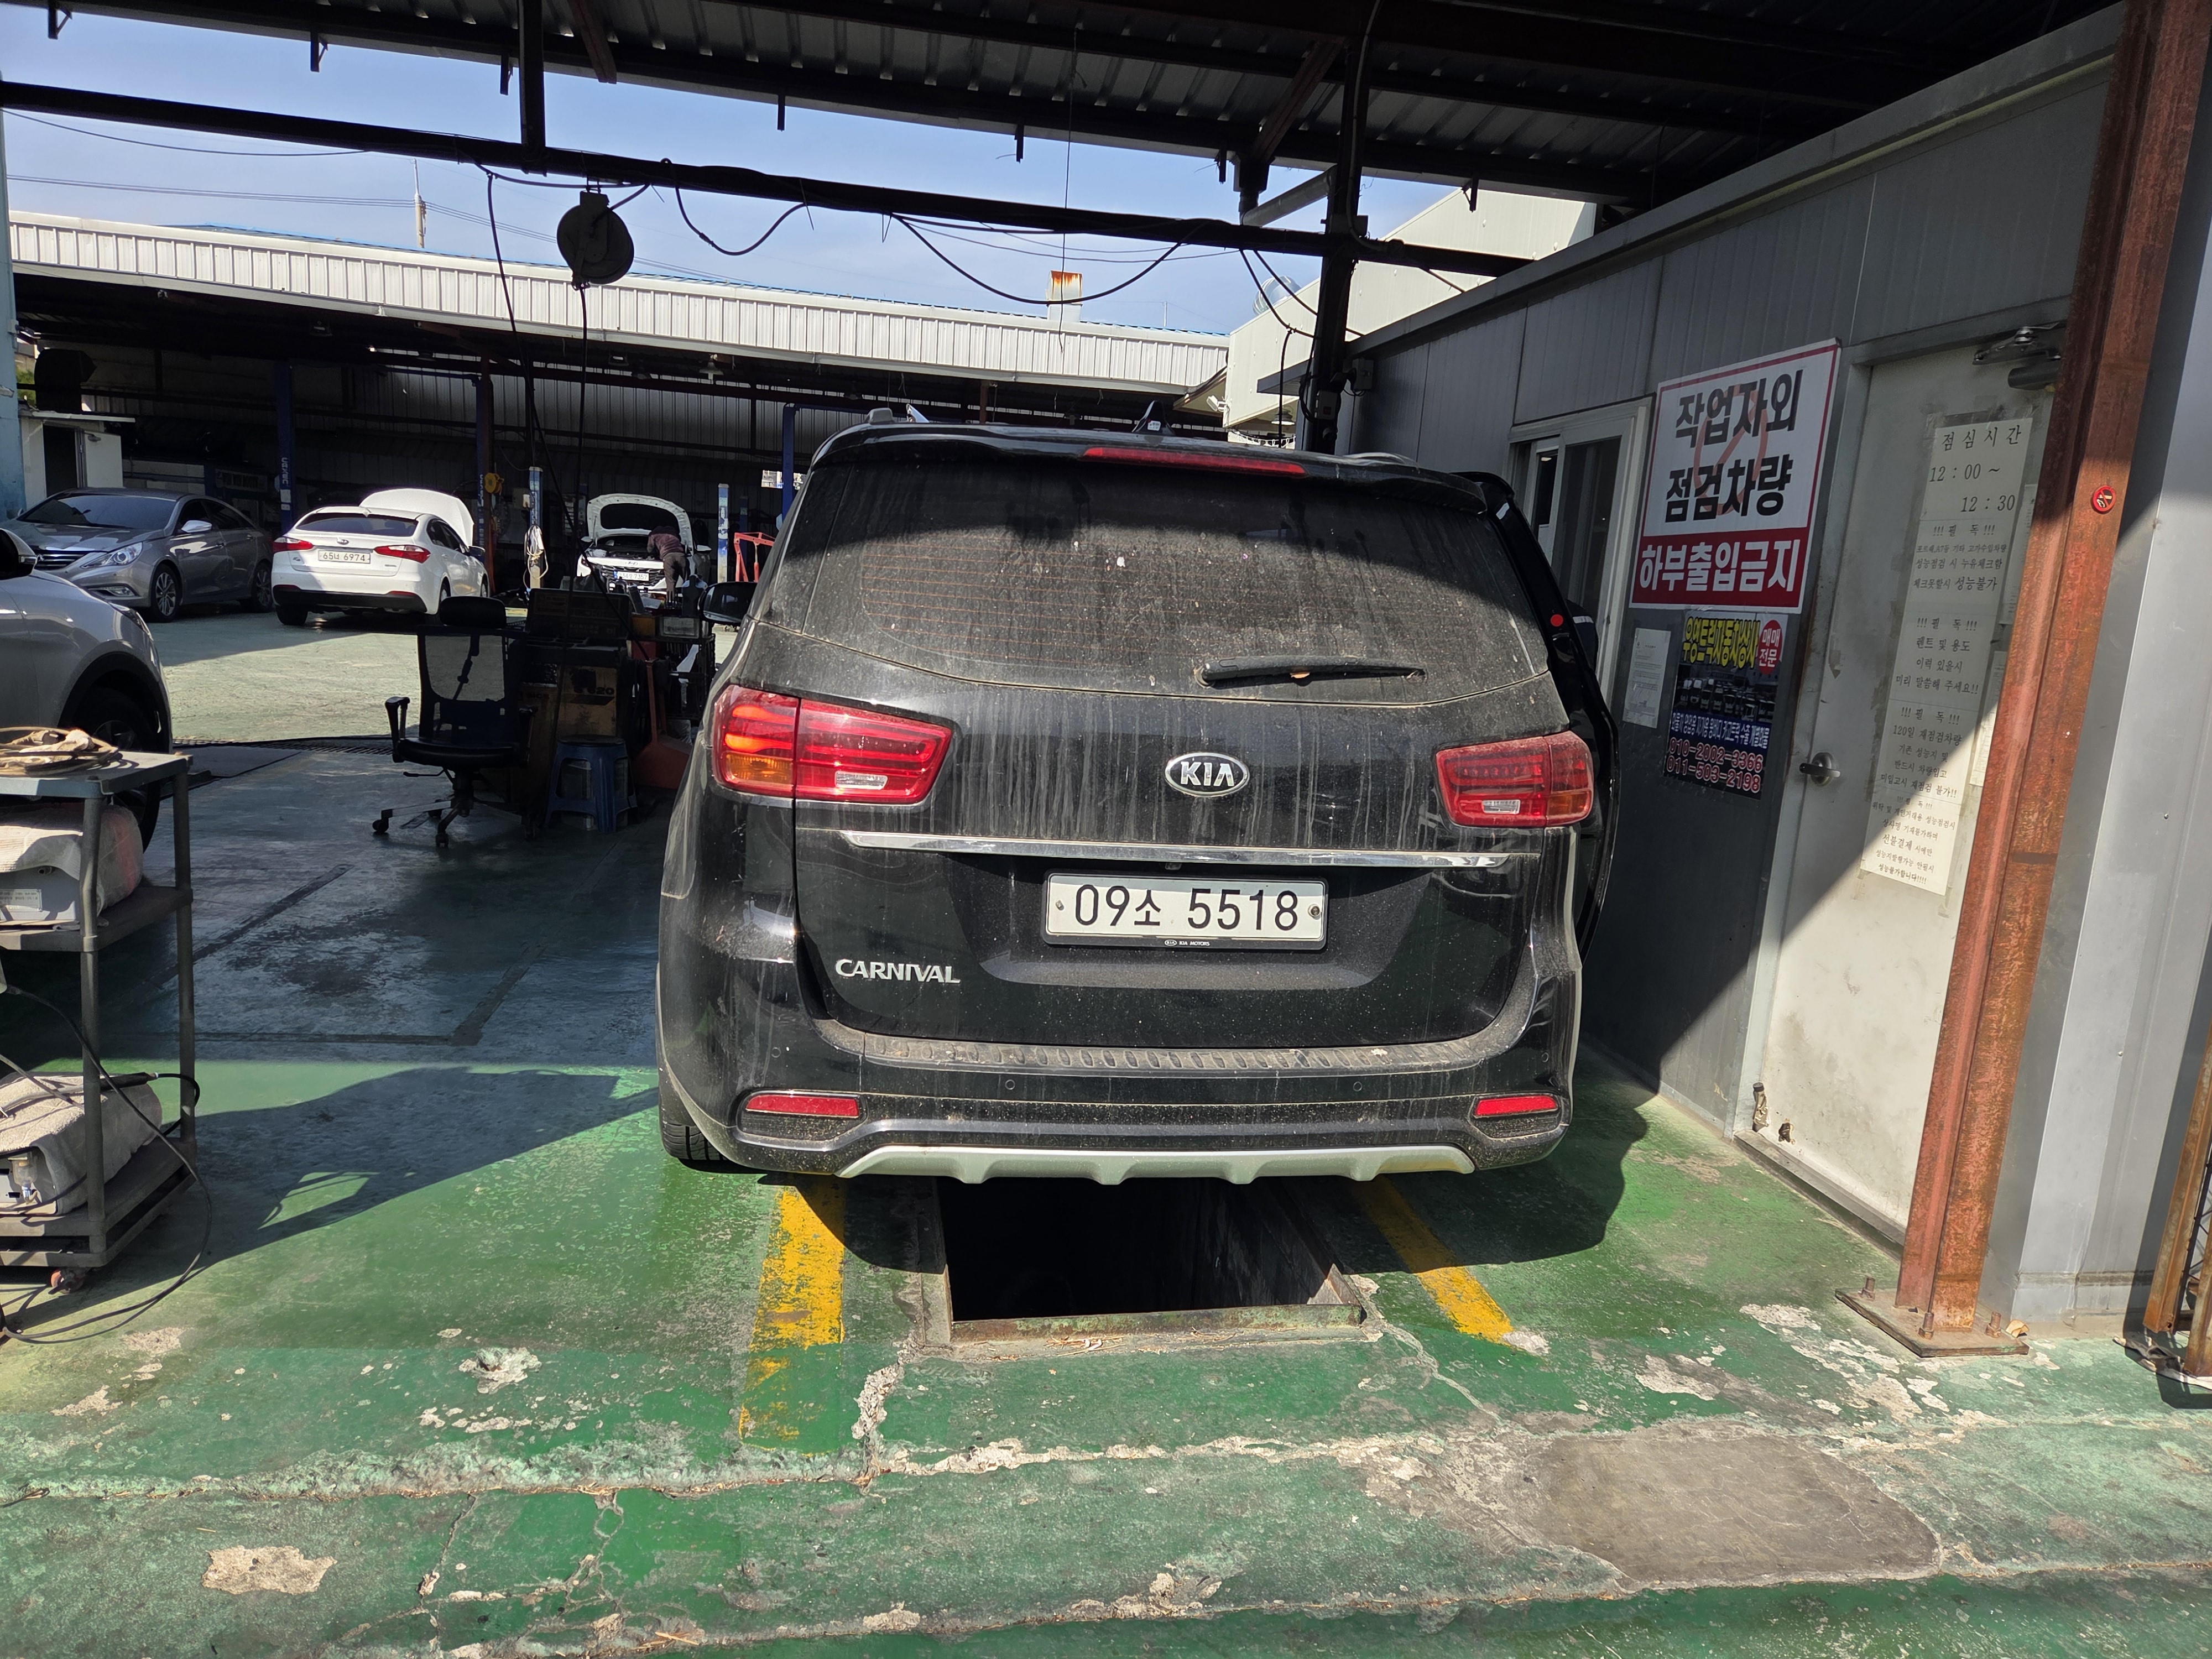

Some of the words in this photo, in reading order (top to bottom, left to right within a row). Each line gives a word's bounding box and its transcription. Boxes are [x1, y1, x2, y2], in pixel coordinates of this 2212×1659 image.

[1676, 370, 1803, 448] 작업자외
[1665, 453, 1793, 523] 점검차량
[343, 553, 366, 561] 6974
[1952, 544, 1965, 554] 기타
[1968, 544, 2007, 554] 고가수입차량
[1639, 539, 1801, 592] 하부출입금지
[1916, 558, 1946, 570] 성능점검
[1949, 558, 1958, 570] 시
[1954, 576, 1998, 592] 성능불가
[1762, 628, 1781, 648] 매매
[1916, 636, 1934, 649] 렌트
[1938, 638, 1947, 651] 및
[1951, 639, 1970, 652] 용도
[1759, 648, 1777, 667] 전문
[1916, 658, 1933, 670] 이력
[1896, 674, 1911, 687] 미리
[1916, 676, 1940, 691] 말씀해
[1944, 680, 1979, 695] 주세요!!
[1893, 725, 1915, 738] 120일
[1918, 728, 1963, 747] 재점검차량
[1669, 737, 1764, 773] 010-2002-3366
[1898, 744, 1913, 755] 기존
[1915, 747, 1938, 760] 성능지
[1180, 761, 1235, 787] KIA
[1666, 754, 1761, 794] 011-503-2198
[1894, 760, 1915, 773] 반드시
[1918, 765, 1948, 778] 차량입고
[1880, 773, 1908, 787] 미입고시
[1911, 780, 1932, 793] 재점검
[1926, 815, 1956, 831] 성능점검시
[1882, 833, 1913, 852] 선불결제
[1914, 845, 1933, 857] 시에만
[1074, 884, 1161, 927] 09소
[1187, 888, 1298, 931] 5518
[835, 958, 961, 983] CARNIVAL
